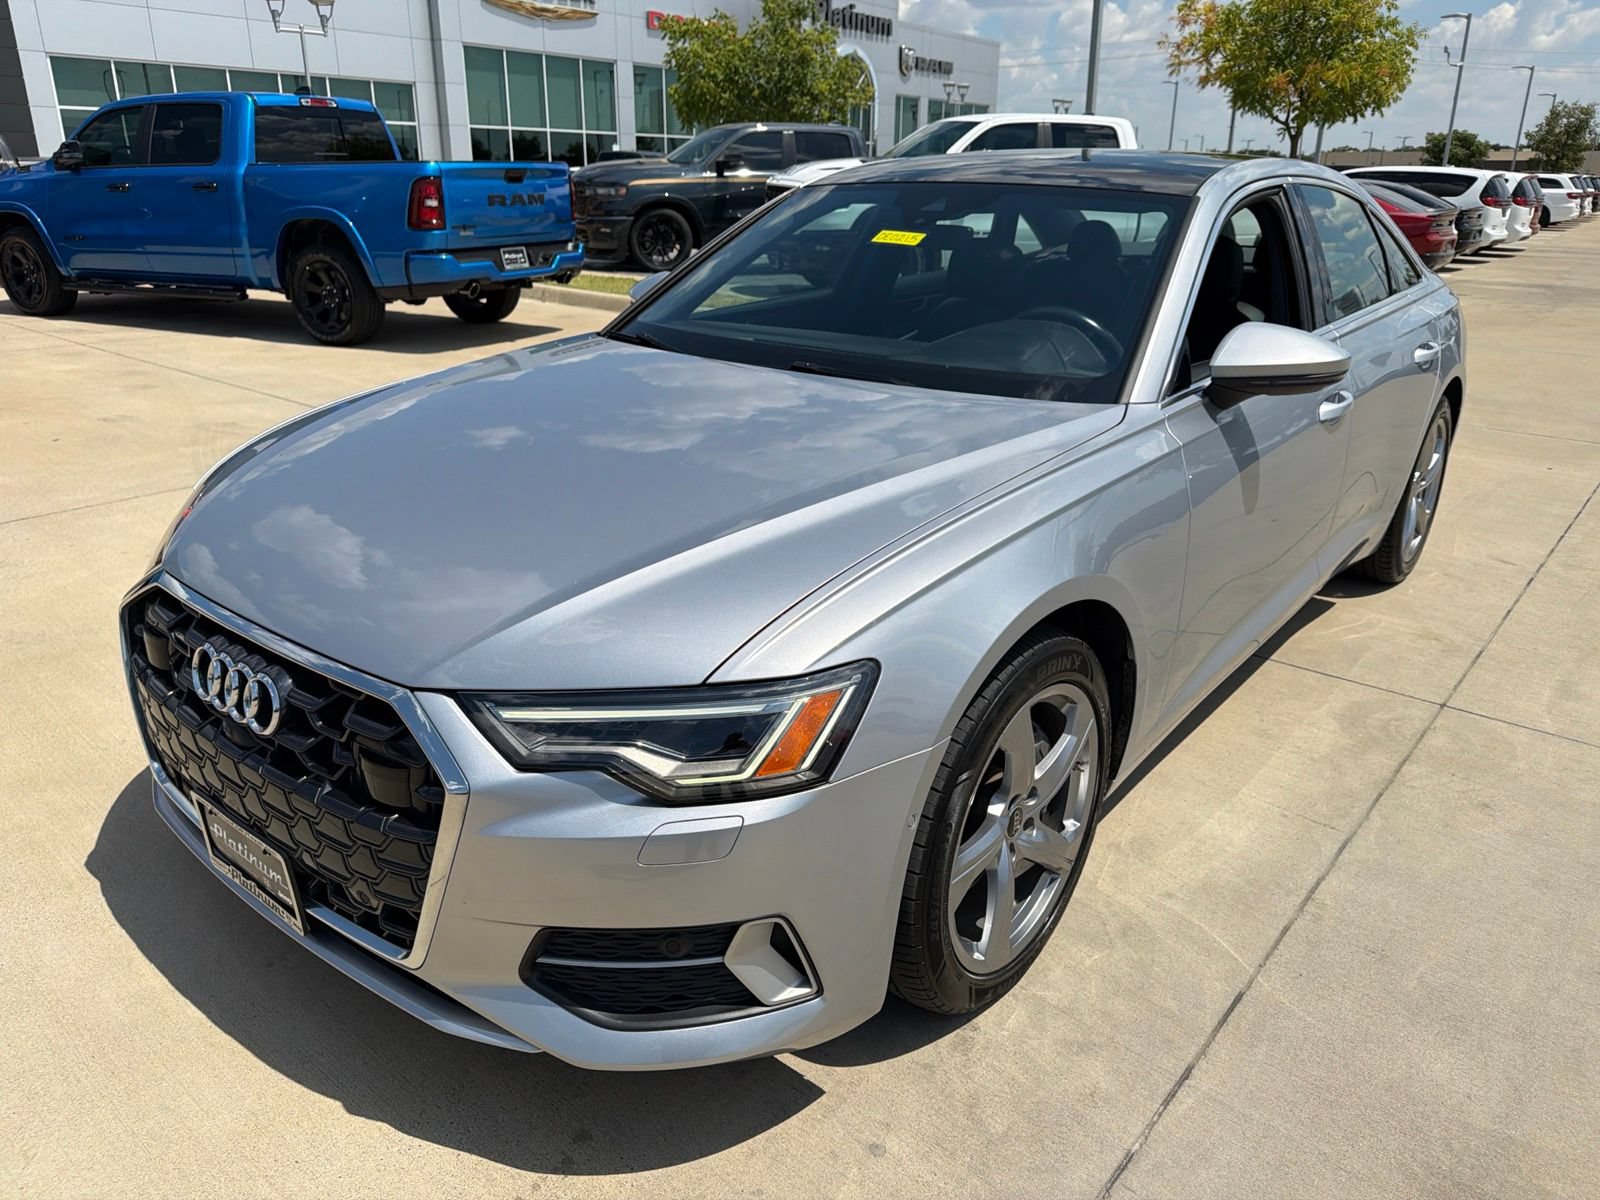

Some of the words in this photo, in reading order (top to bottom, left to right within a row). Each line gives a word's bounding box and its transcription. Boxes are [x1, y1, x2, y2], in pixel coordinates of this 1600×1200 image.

[811, 0, 892, 37] Platinum
[914, 56, 953, 75] RAM
[487, 193, 545, 207] RAM
[1036, 654, 1083, 681] PRINX
[211, 823, 288, 889] Platinum
